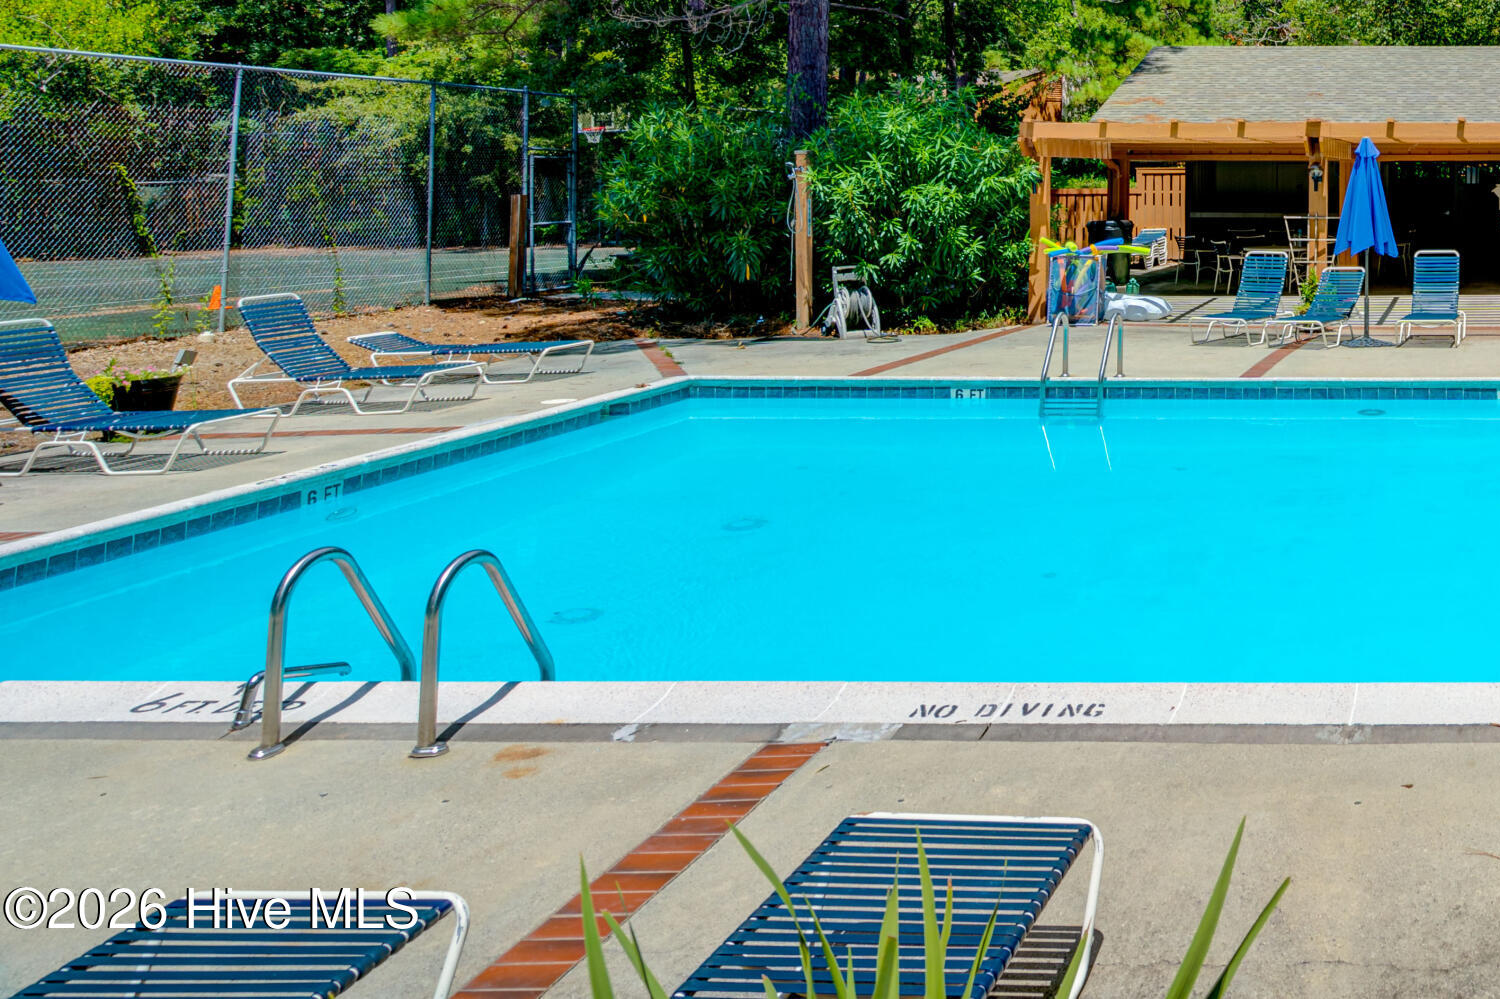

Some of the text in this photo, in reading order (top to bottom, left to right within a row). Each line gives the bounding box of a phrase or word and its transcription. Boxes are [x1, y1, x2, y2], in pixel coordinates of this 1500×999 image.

[955, 388, 984, 399] 6 FT
[307, 483, 342, 505] 6 FT
[129, 692, 185, 713] 6
[161, 700, 219, 714] FT.
[908, 702, 1106, 719] NO DIVING
